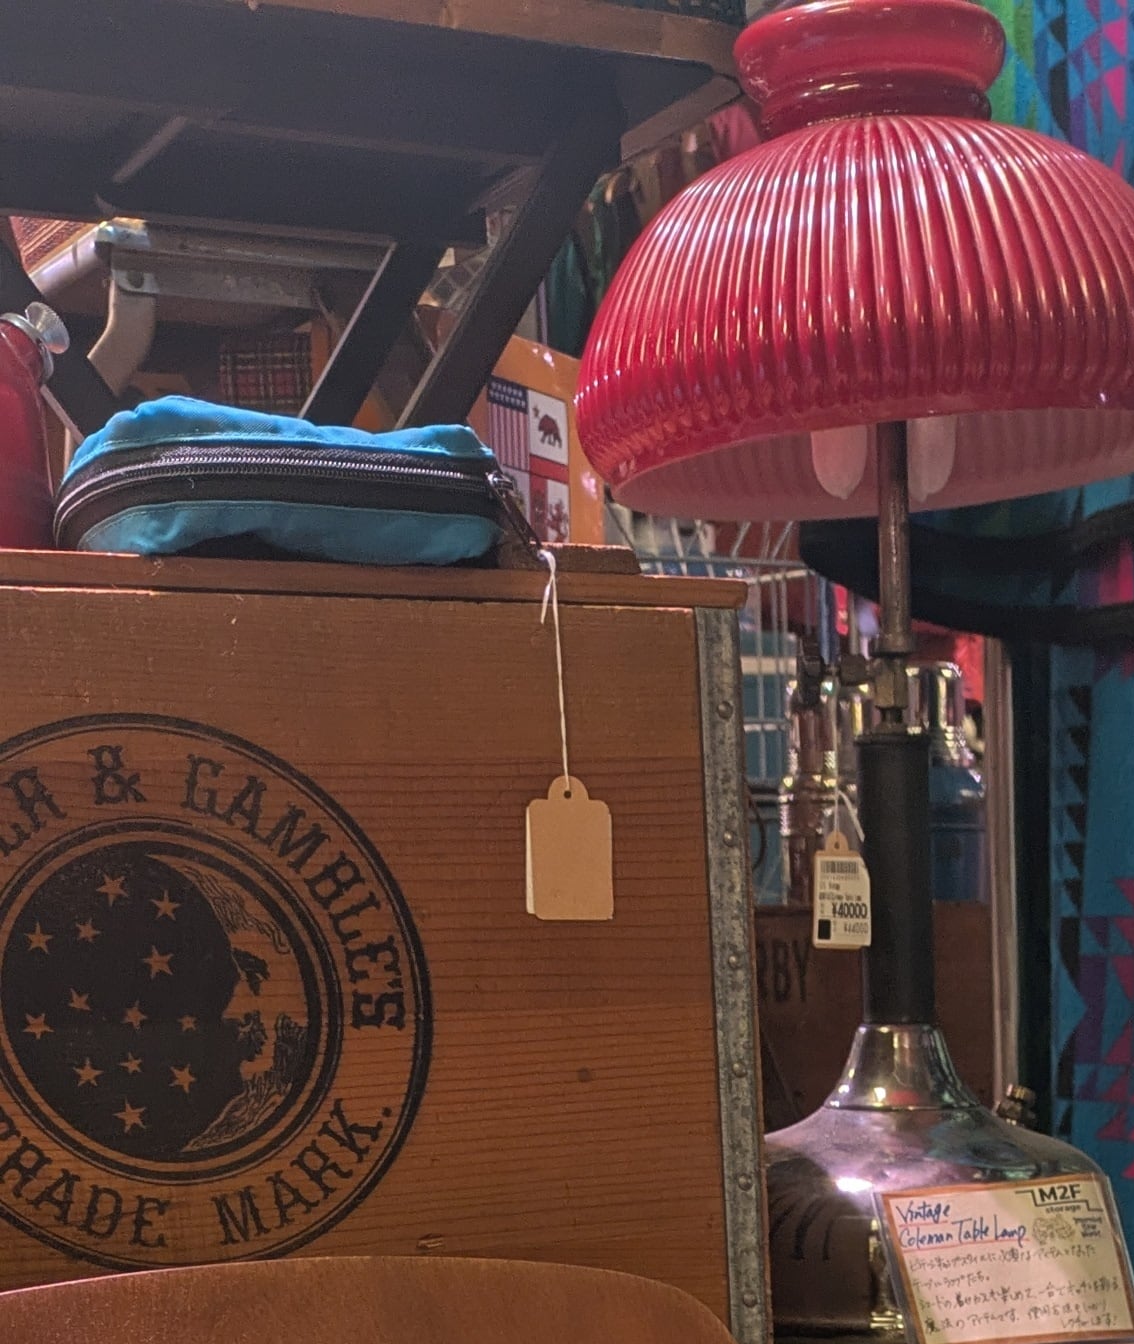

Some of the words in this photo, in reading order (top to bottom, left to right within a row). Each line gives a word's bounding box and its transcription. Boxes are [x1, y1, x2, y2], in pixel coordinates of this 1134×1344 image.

[87, 745, 147, 805] &
[212, 1097, 394, 1246] MARK.
[1038, 1184, 1081, 1202] M2F
[896, 1202, 950, 1224] Vintage
[900, 1228, 953, 1249] Coleman
[951, 1218, 989, 1243] Table
[994, 1215, 1026, 1248] Lamp
